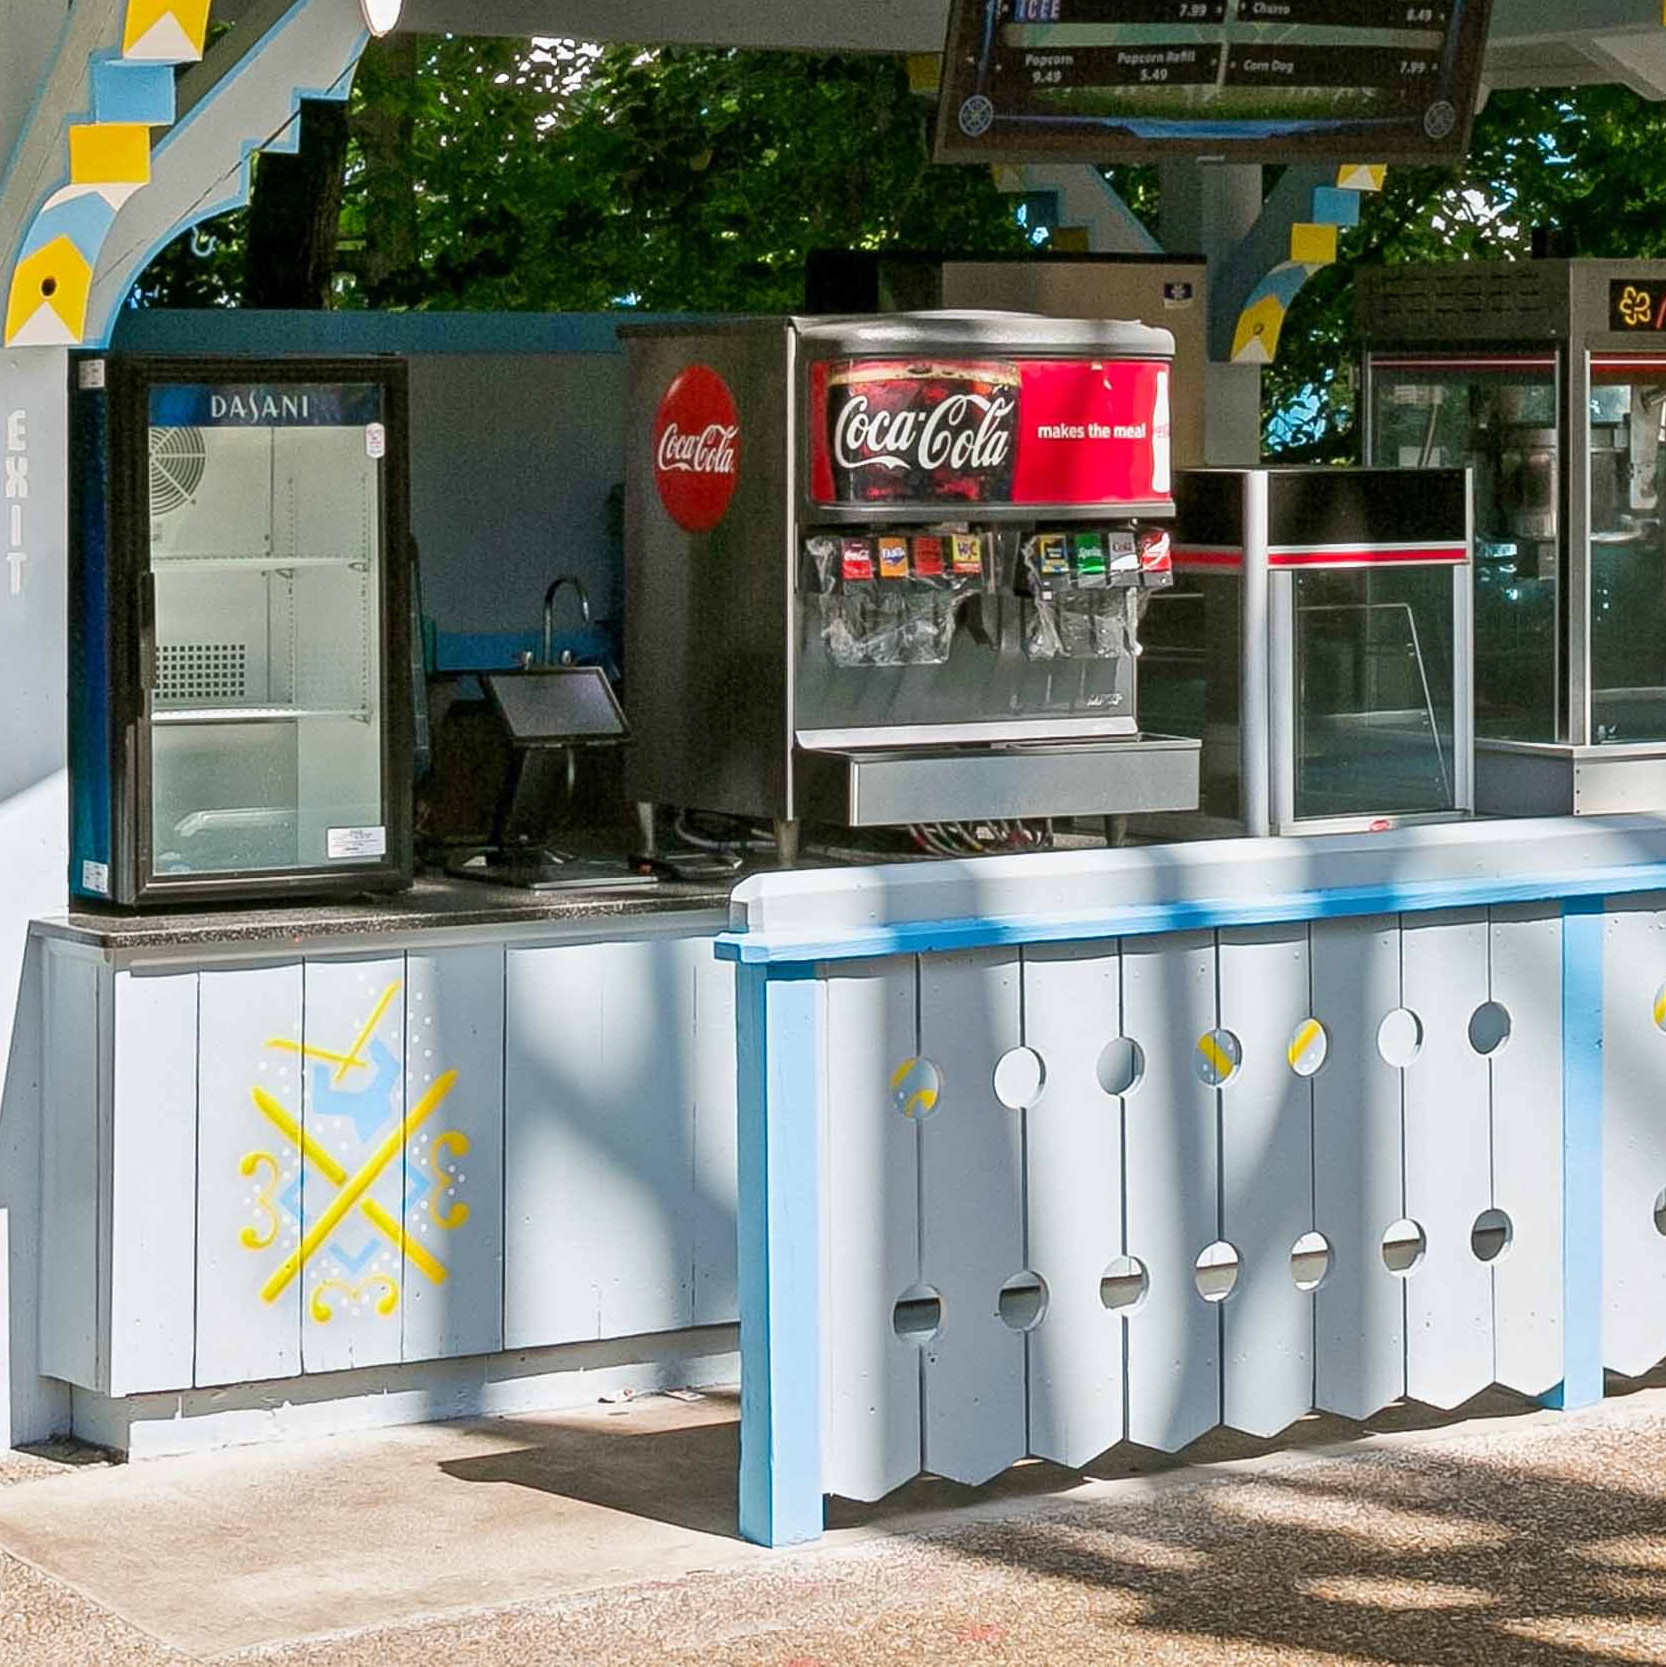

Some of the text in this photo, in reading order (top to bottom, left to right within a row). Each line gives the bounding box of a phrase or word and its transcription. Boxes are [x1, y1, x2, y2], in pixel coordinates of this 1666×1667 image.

[1253, 1, 1291, 15] Churro
[1025, 53, 1074, 67] Popcorn
[1117, 51, 1164, 65] Popcorn
[1243, 60, 1270, 72] Corn
[1271, 60, 1294, 74] Dog
[210, 389, 309, 424] DASANI
[835, 393, 1016, 470] Coca-Cola
[1037, 423, 1085, 440] makes
[1086, 422, 1111, 439] the
[1112, 422, 1147, 439] meal
[658, 423, 739, 473] Coca-Cola
[5, 409, 29, 595] EXIT
